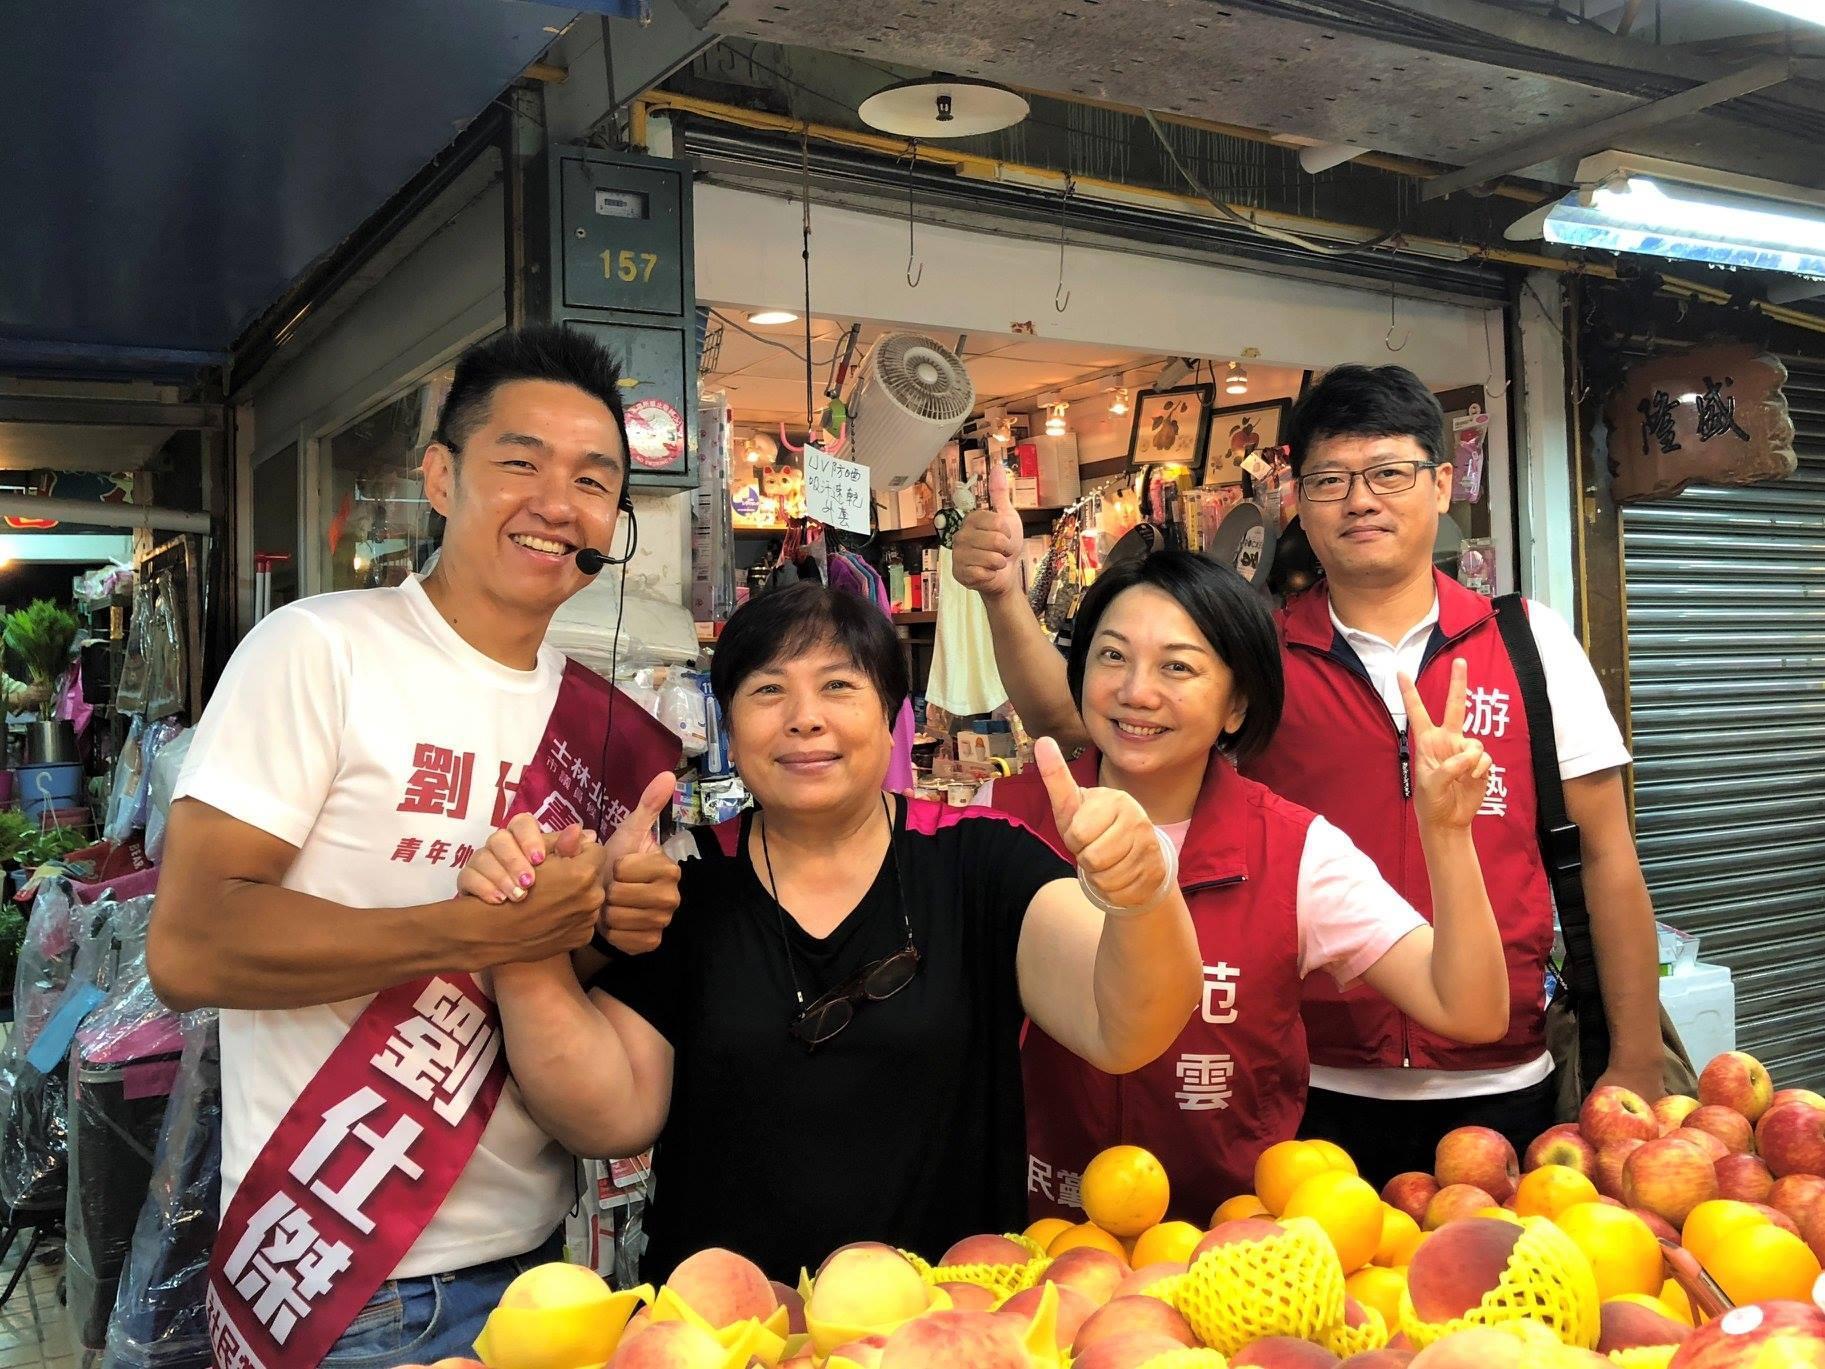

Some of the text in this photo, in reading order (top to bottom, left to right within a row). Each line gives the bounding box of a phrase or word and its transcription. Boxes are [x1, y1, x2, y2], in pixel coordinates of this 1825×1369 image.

[600, 249, 657, 282] 157
[223, 976, 502, 1346] 劉仕傑
